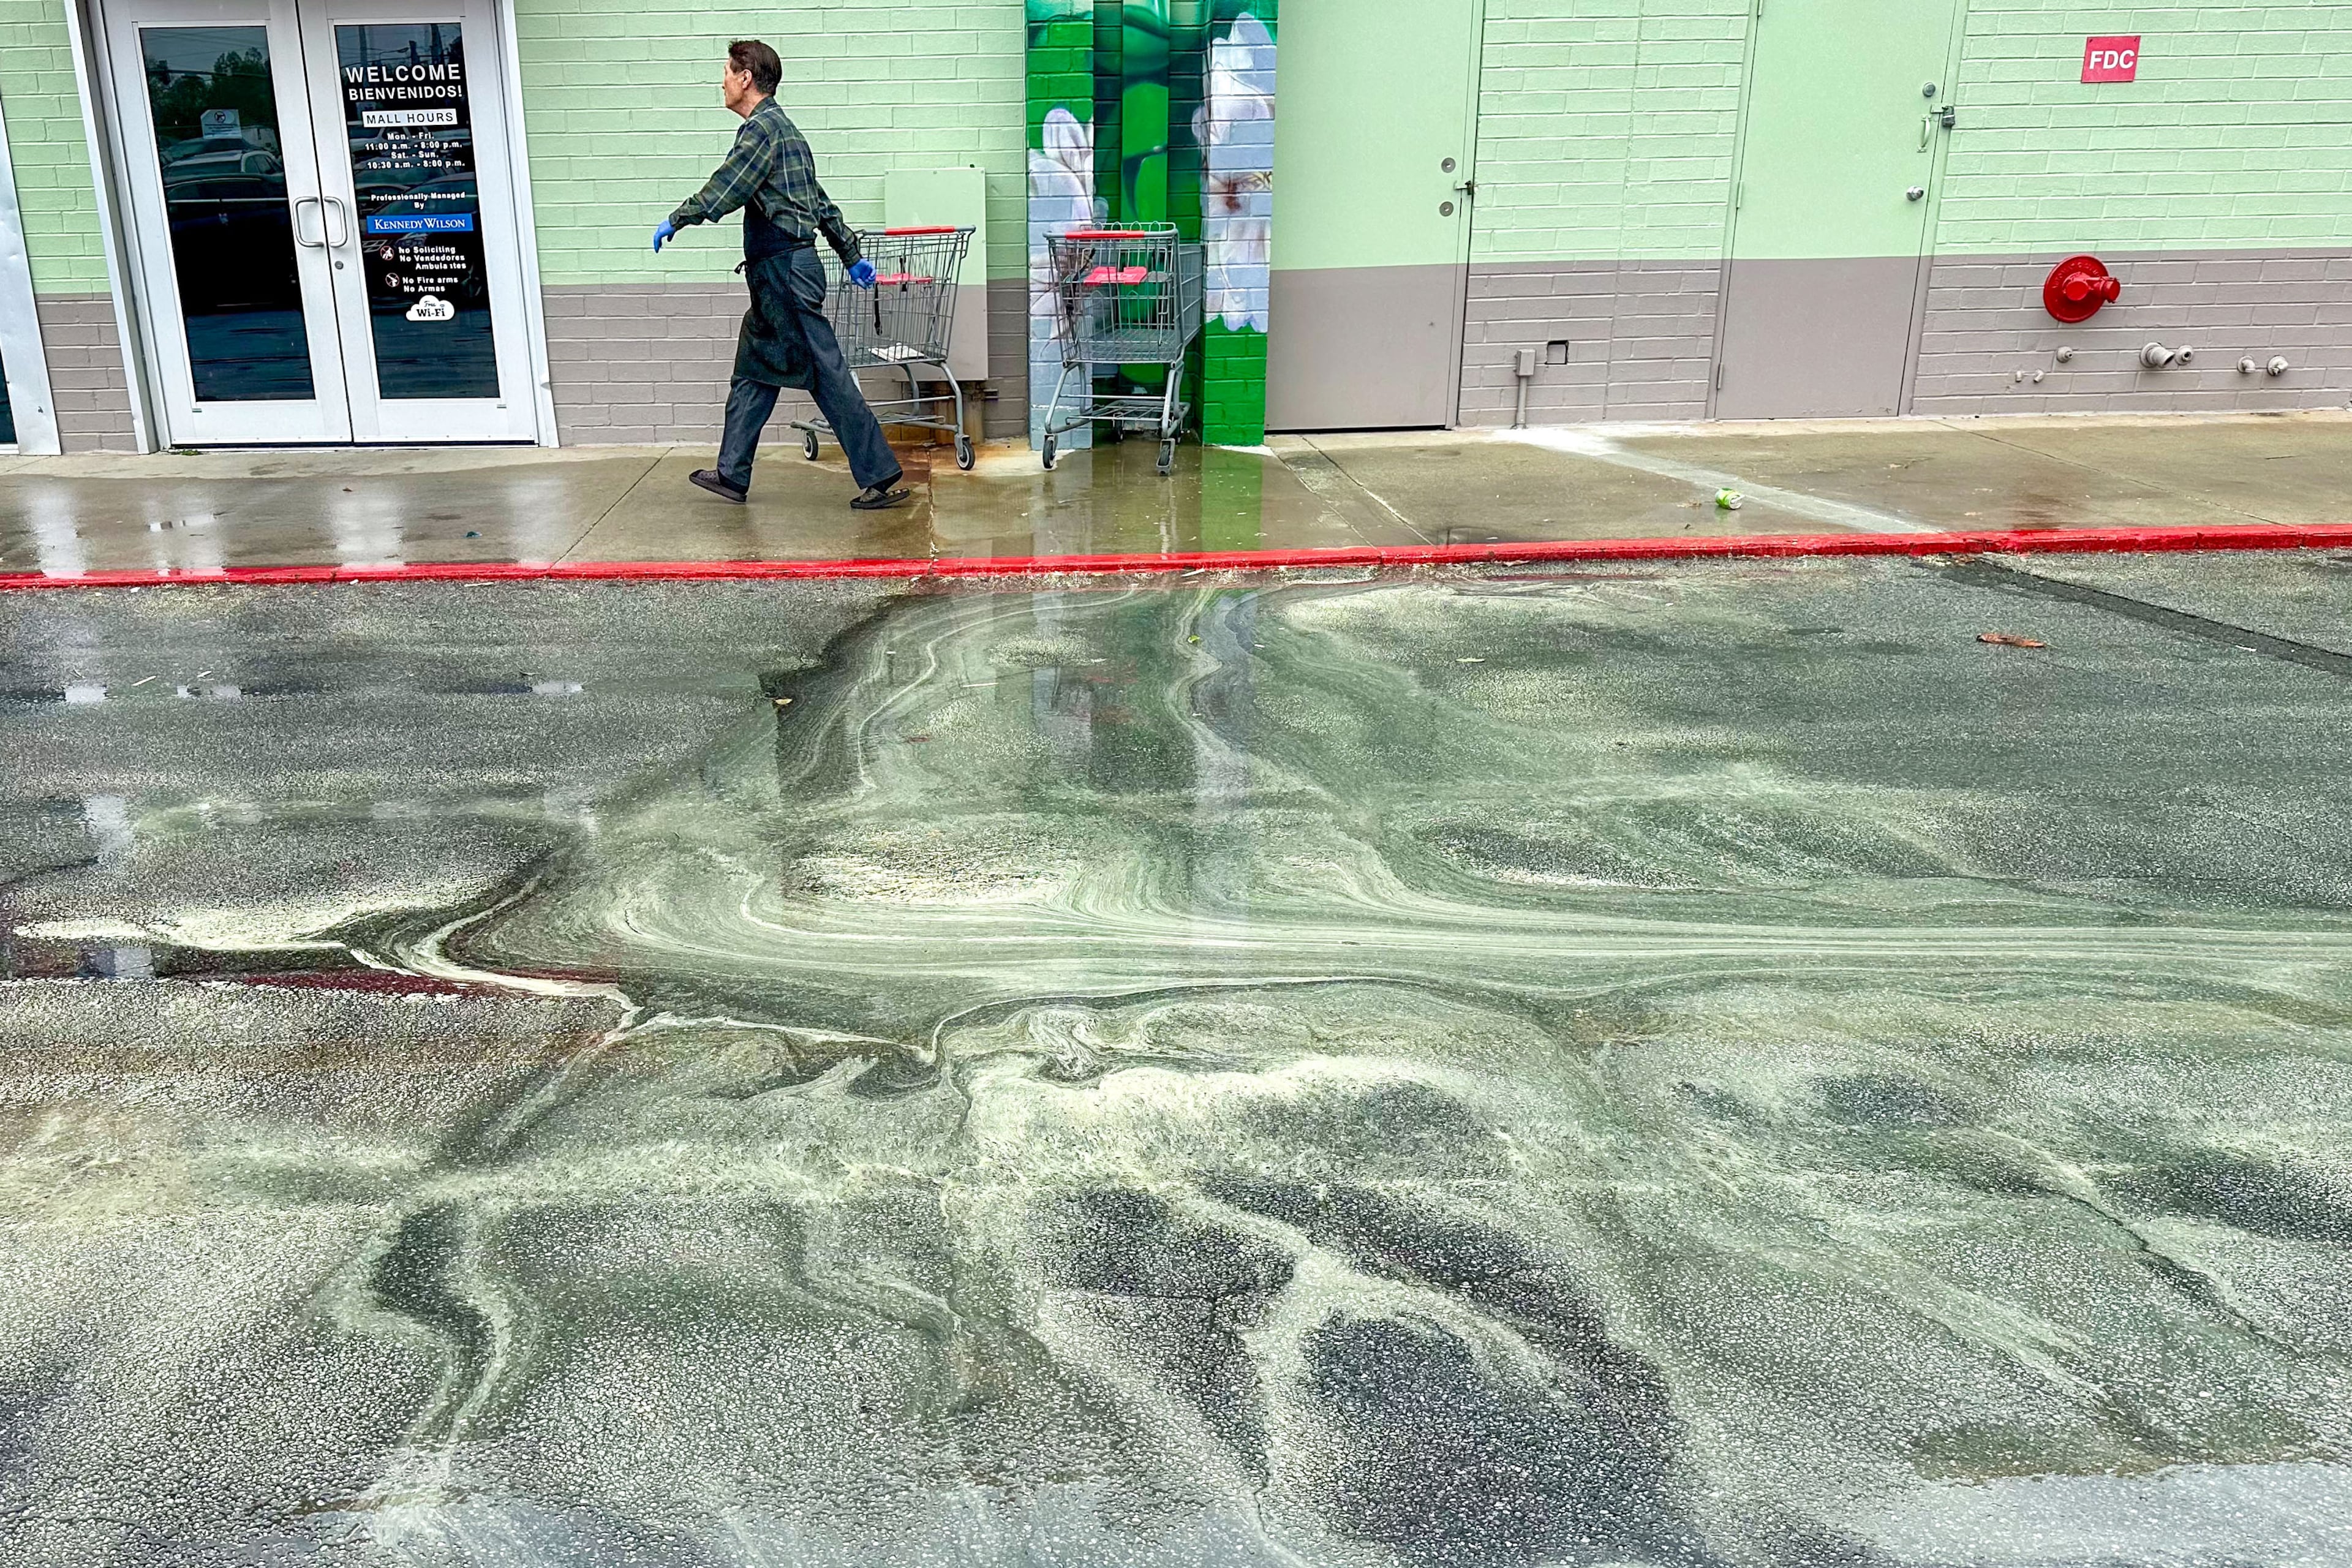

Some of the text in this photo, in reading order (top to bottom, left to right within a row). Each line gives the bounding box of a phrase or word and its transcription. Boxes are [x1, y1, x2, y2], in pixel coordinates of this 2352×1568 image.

[2089, 49, 2135, 70] FDC
[345, 64, 461, 83] WELCOME
[349, 85, 462, 100] BIENVENIDOS!
[367, 113, 453, 124] MALL HOURS
[374, 218, 466, 230] KENNEDY WILSON
[413, 246, 456, 254] Soliciting
[416, 308, 445, 317] Wi-Fi
